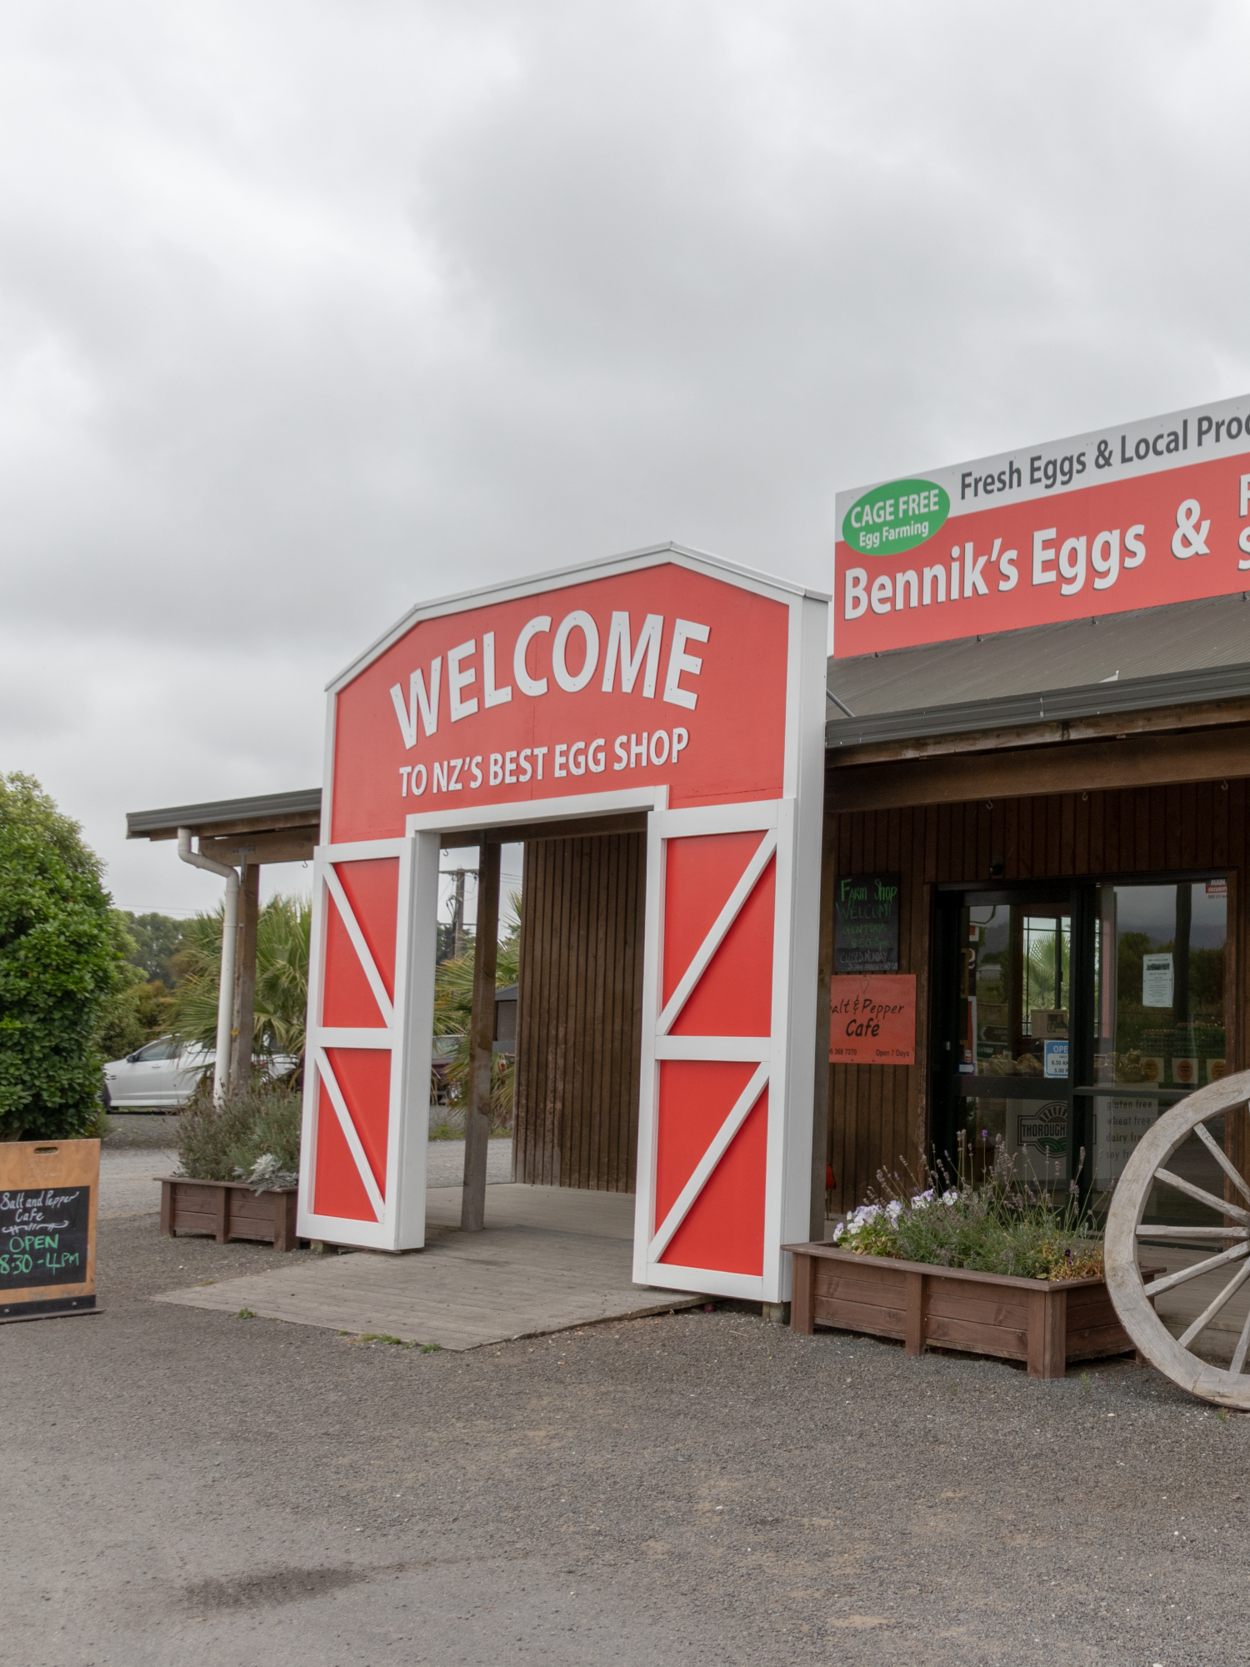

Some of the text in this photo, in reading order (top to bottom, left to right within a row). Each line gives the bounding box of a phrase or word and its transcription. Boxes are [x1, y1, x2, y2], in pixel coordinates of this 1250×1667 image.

[961, 460, 1022, 500] Fresh
[1030, 452, 1087, 489] Eggs
[1095, 439, 1114, 469] &
[1121, 418, 1188, 464] Local
[851, 489, 939, 528] CAGE FREE
[859, 520, 929, 549] Egg Farming
[844, 498, 1211, 621] Bennik's Eggs &
[389, 610, 710, 750] WELCOME
[399, 727, 689, 797] TO NZ'S BEST EGG SHOP
[830, 998, 850, 1013] alt
[862, 998, 905, 1020] Pepper
[876, 1049, 890, 1057] Open
[896, 1050, 910, 1058] Days
[1135, 1099, 1152, 1108] free
[1107, 1116, 1151, 1125] wheat free
[1106, 1132, 1127, 1144] dairy
[1123, 1149, 1131, 1158] fr
[0, 1190, 80, 1210] Salt and Pepper
[9, 1234, 59, 1253] OPEN
